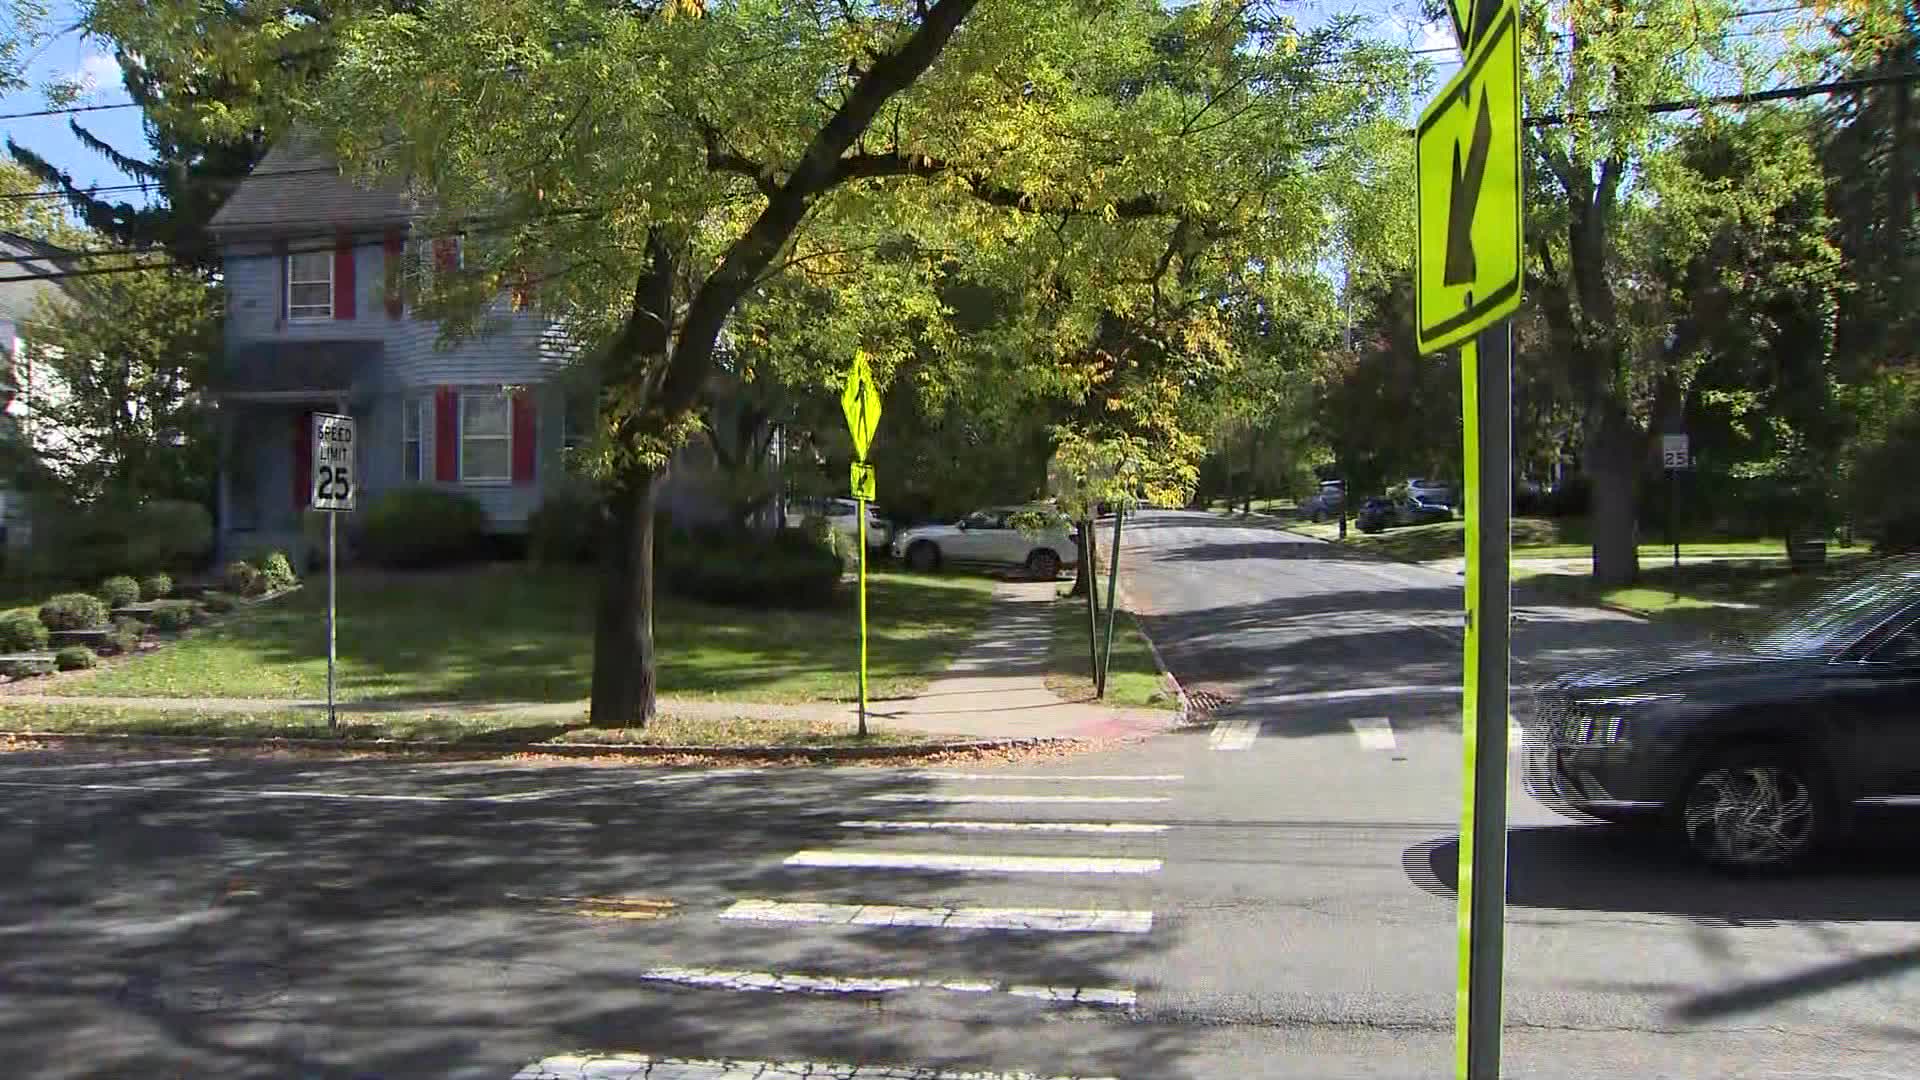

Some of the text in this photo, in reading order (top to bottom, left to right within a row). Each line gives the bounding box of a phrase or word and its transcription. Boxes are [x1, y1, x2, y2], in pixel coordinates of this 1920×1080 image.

[318, 425, 351, 441] SPEED
[320, 447, 347, 461] LIMIT
[1665, 452, 1687, 465] 25
[319, 466, 349, 499] 25
